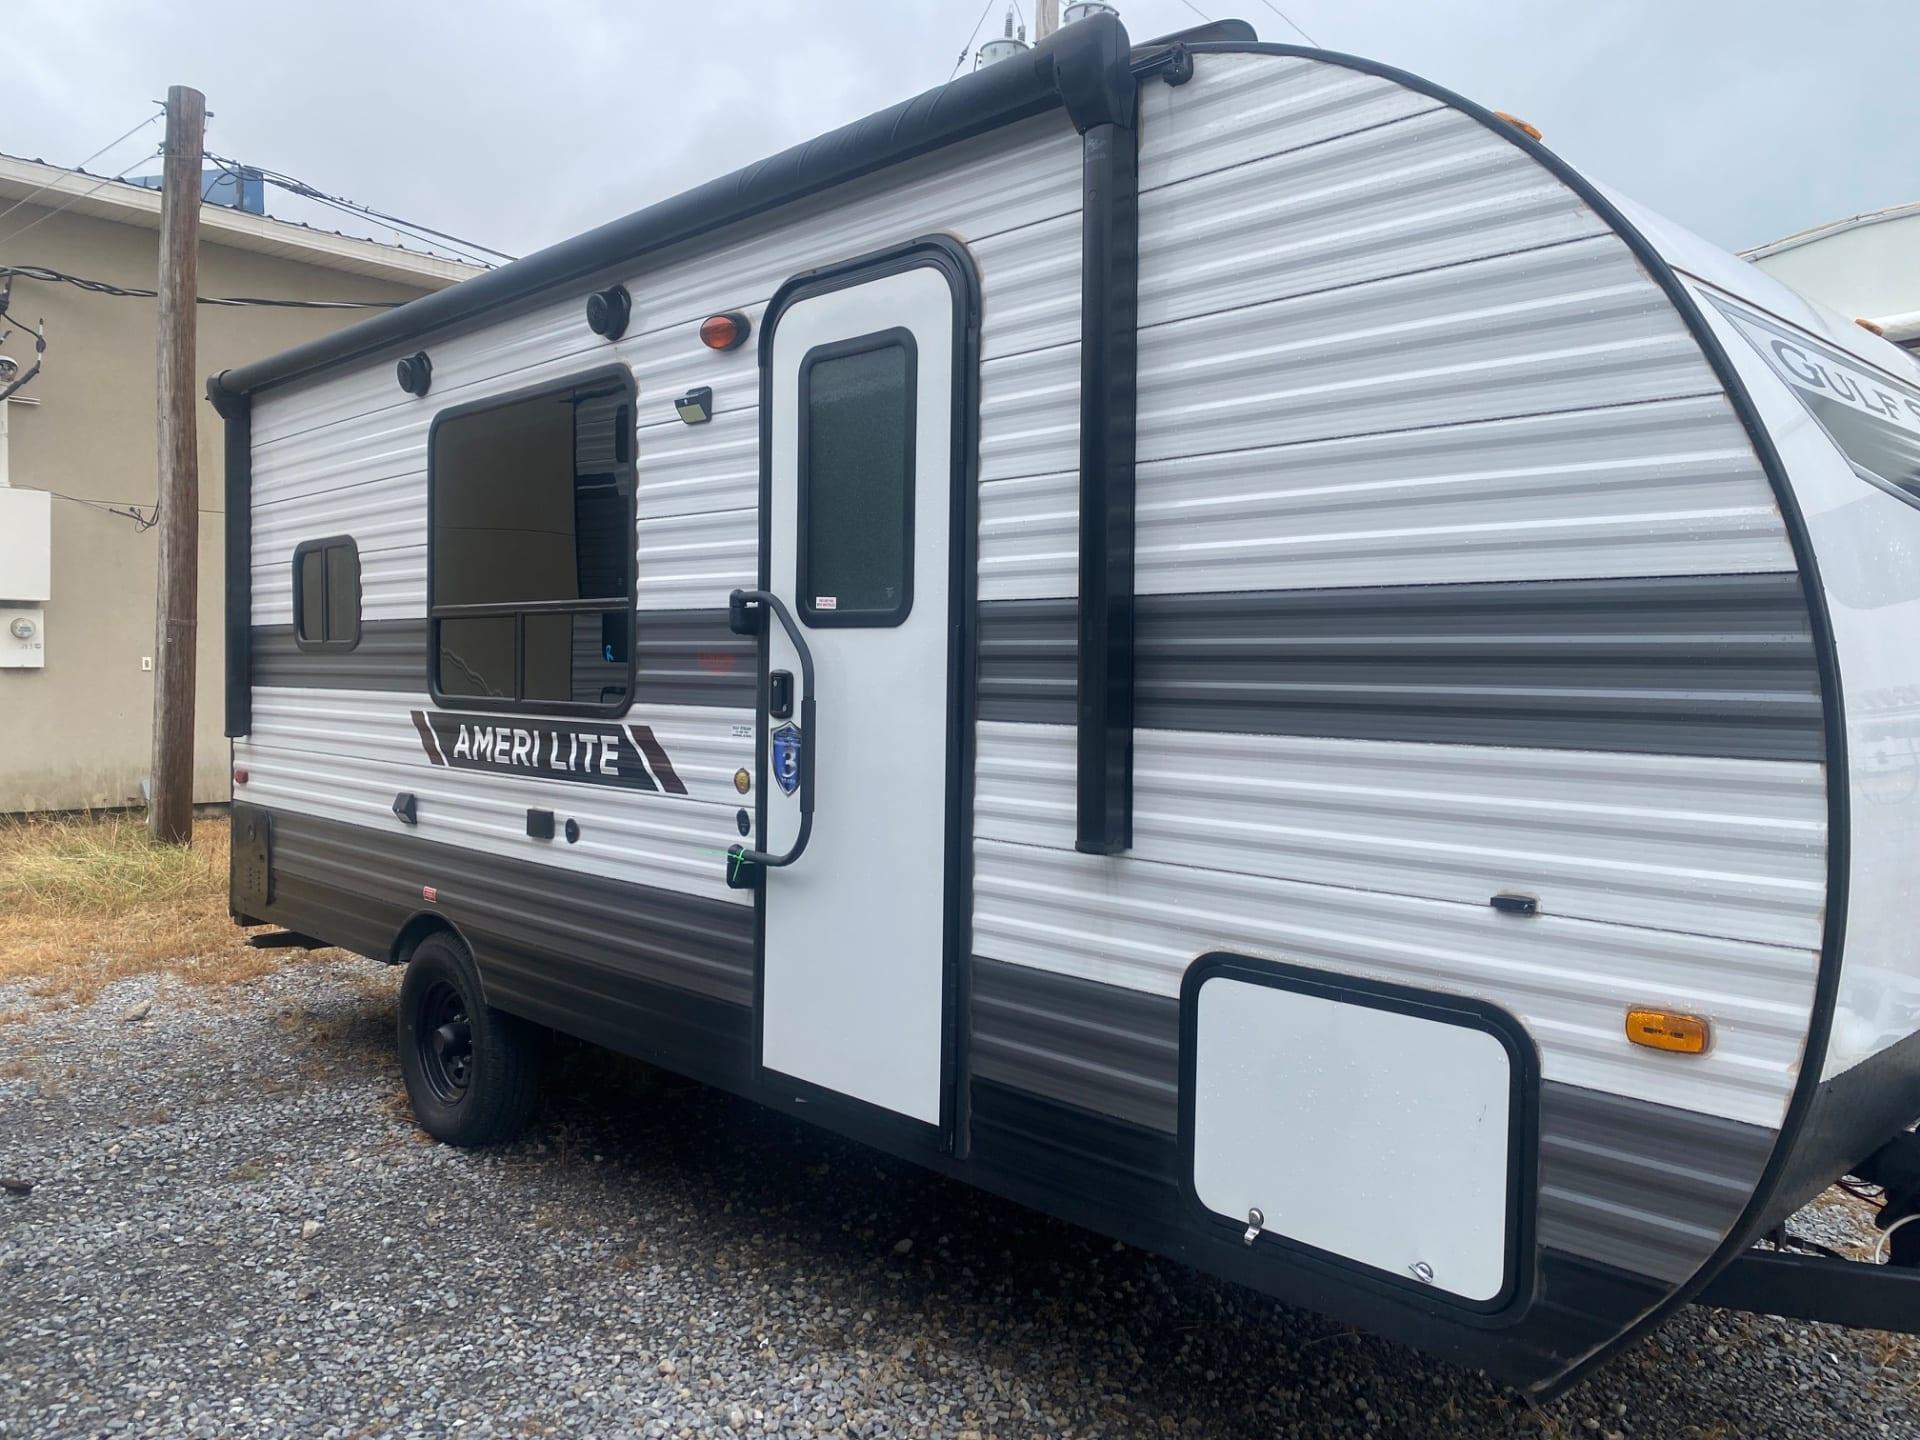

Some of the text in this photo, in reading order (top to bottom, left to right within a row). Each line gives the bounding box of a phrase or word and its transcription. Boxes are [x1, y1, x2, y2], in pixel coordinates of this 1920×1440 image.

[1770, 339, 1898, 420] GULF
[453, 724, 619, 776] AMERI LITE
[782, 750, 798, 778] 3
